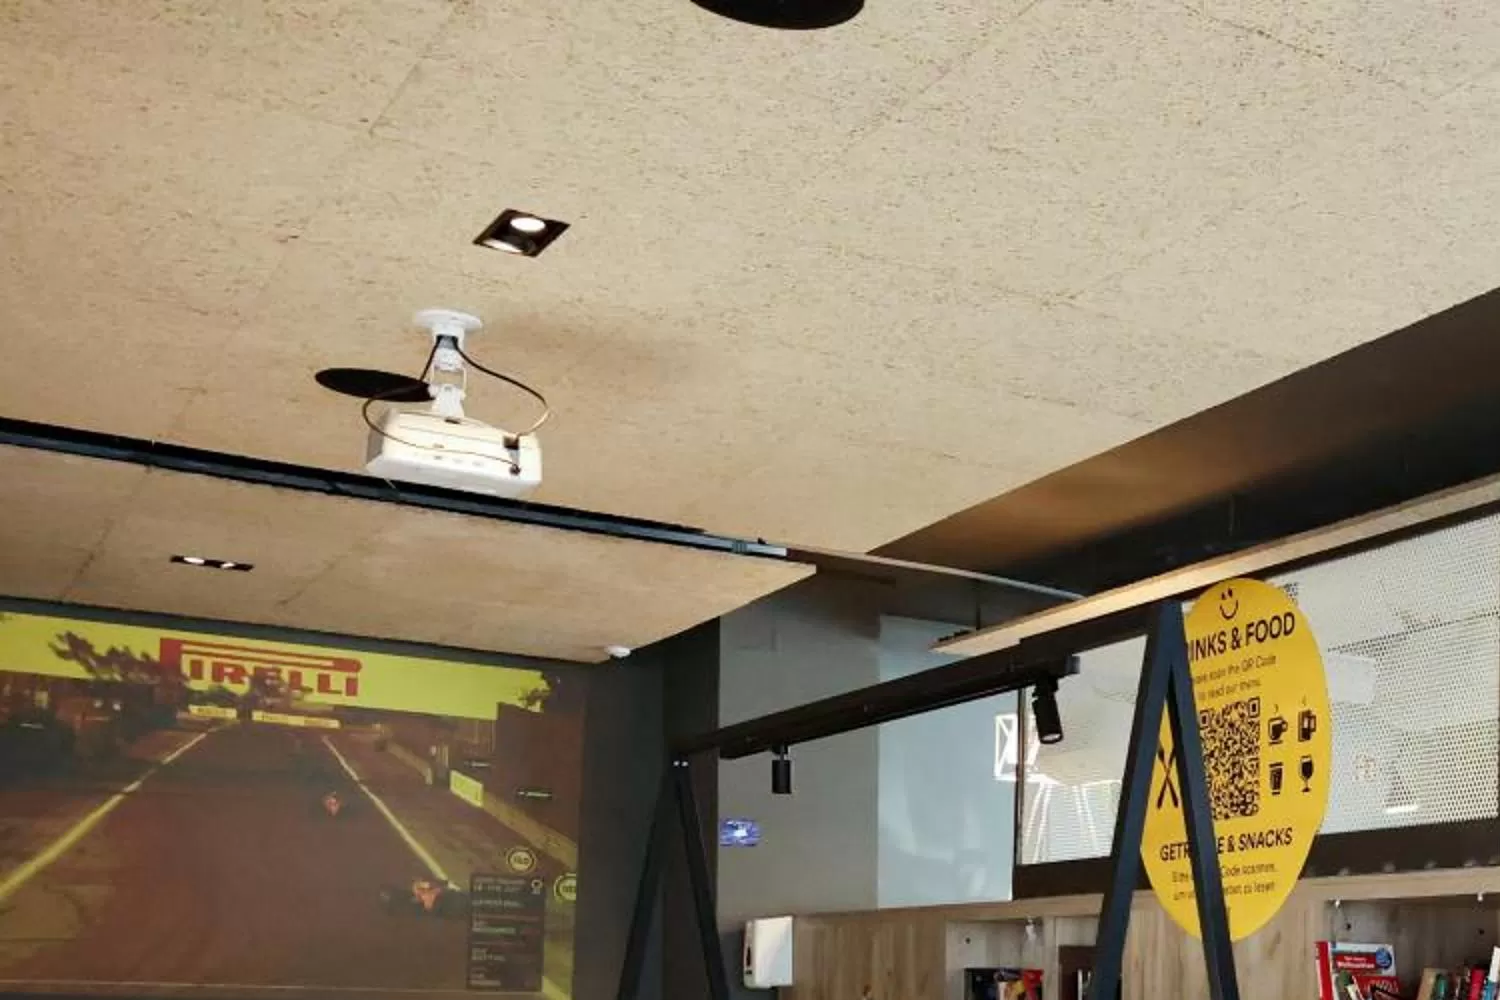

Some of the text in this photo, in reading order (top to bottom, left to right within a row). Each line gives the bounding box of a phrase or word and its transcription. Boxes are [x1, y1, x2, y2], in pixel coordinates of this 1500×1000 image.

[1191, 611, 1296, 661] INKS & FOOD
[1160, 827, 1294, 862] GETRE & SNACKS
